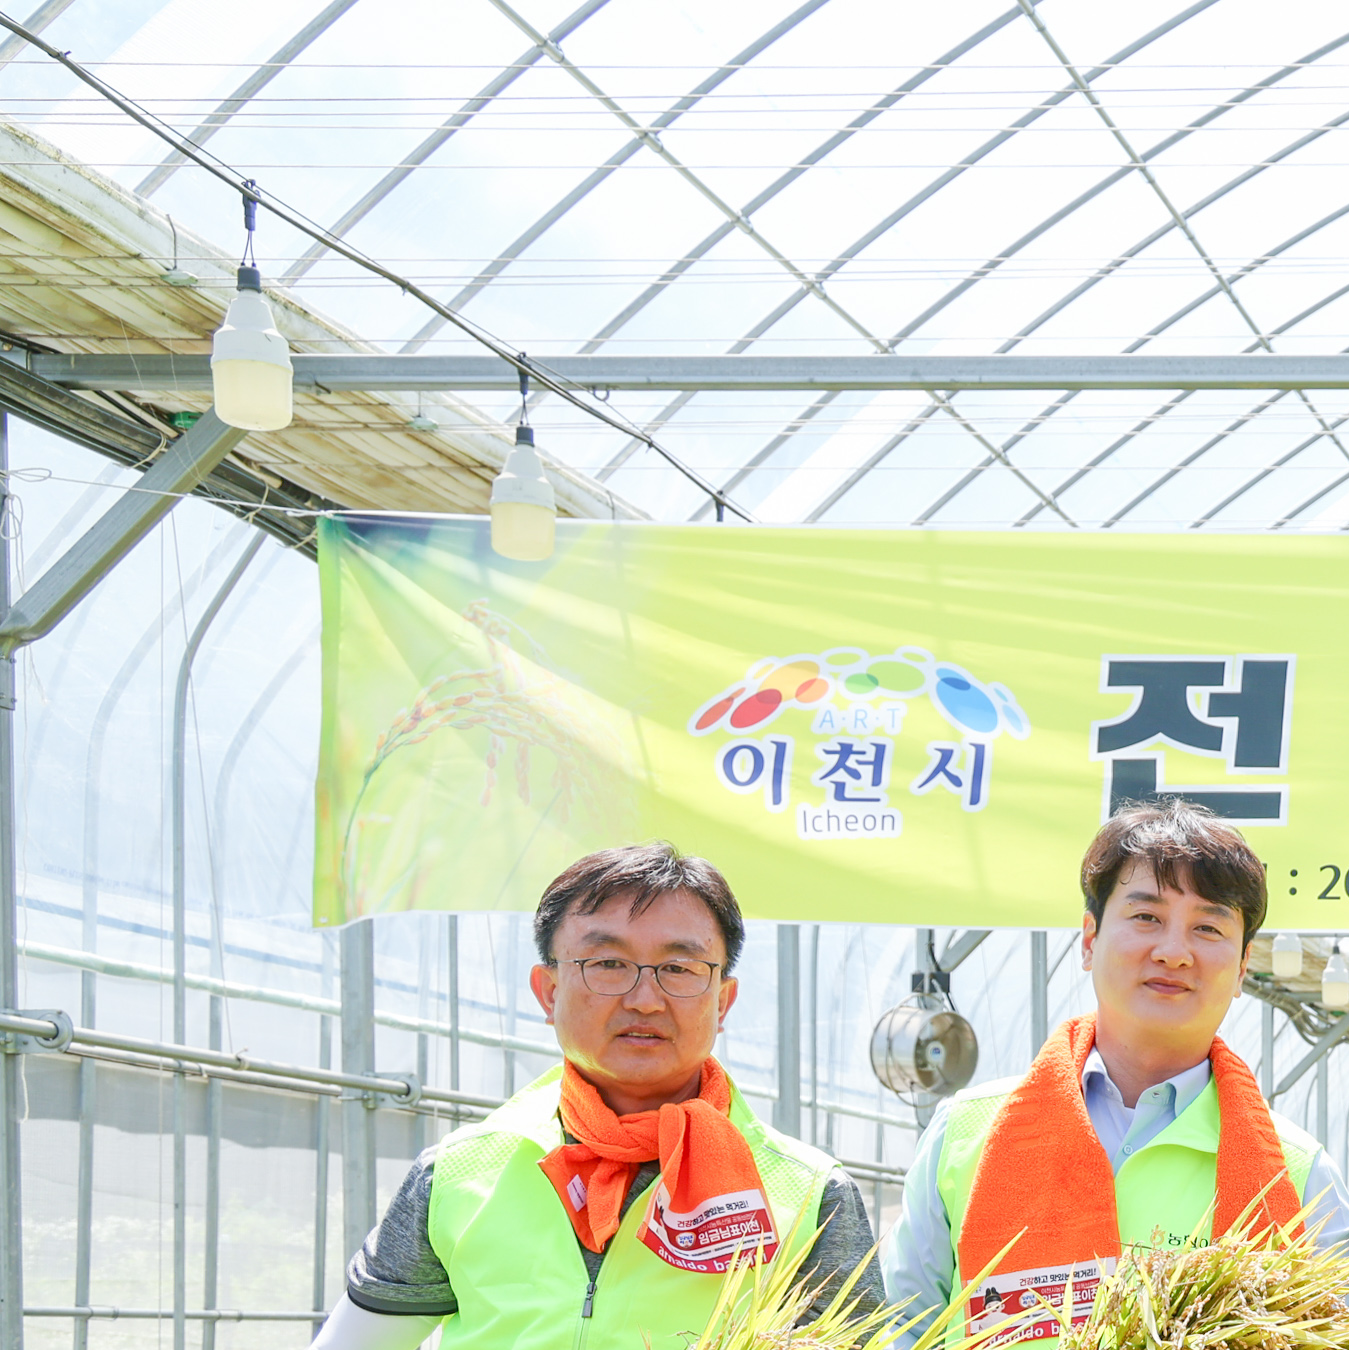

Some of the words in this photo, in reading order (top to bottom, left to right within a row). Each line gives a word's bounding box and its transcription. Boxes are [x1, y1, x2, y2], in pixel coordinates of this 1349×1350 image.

[721, 740, 987, 807] 이천시
[802, 809, 896, 833] Icheon
[657, 1245, 708, 1271] arnaldo
[1019, 1275, 1049, 1287] 건강하고
